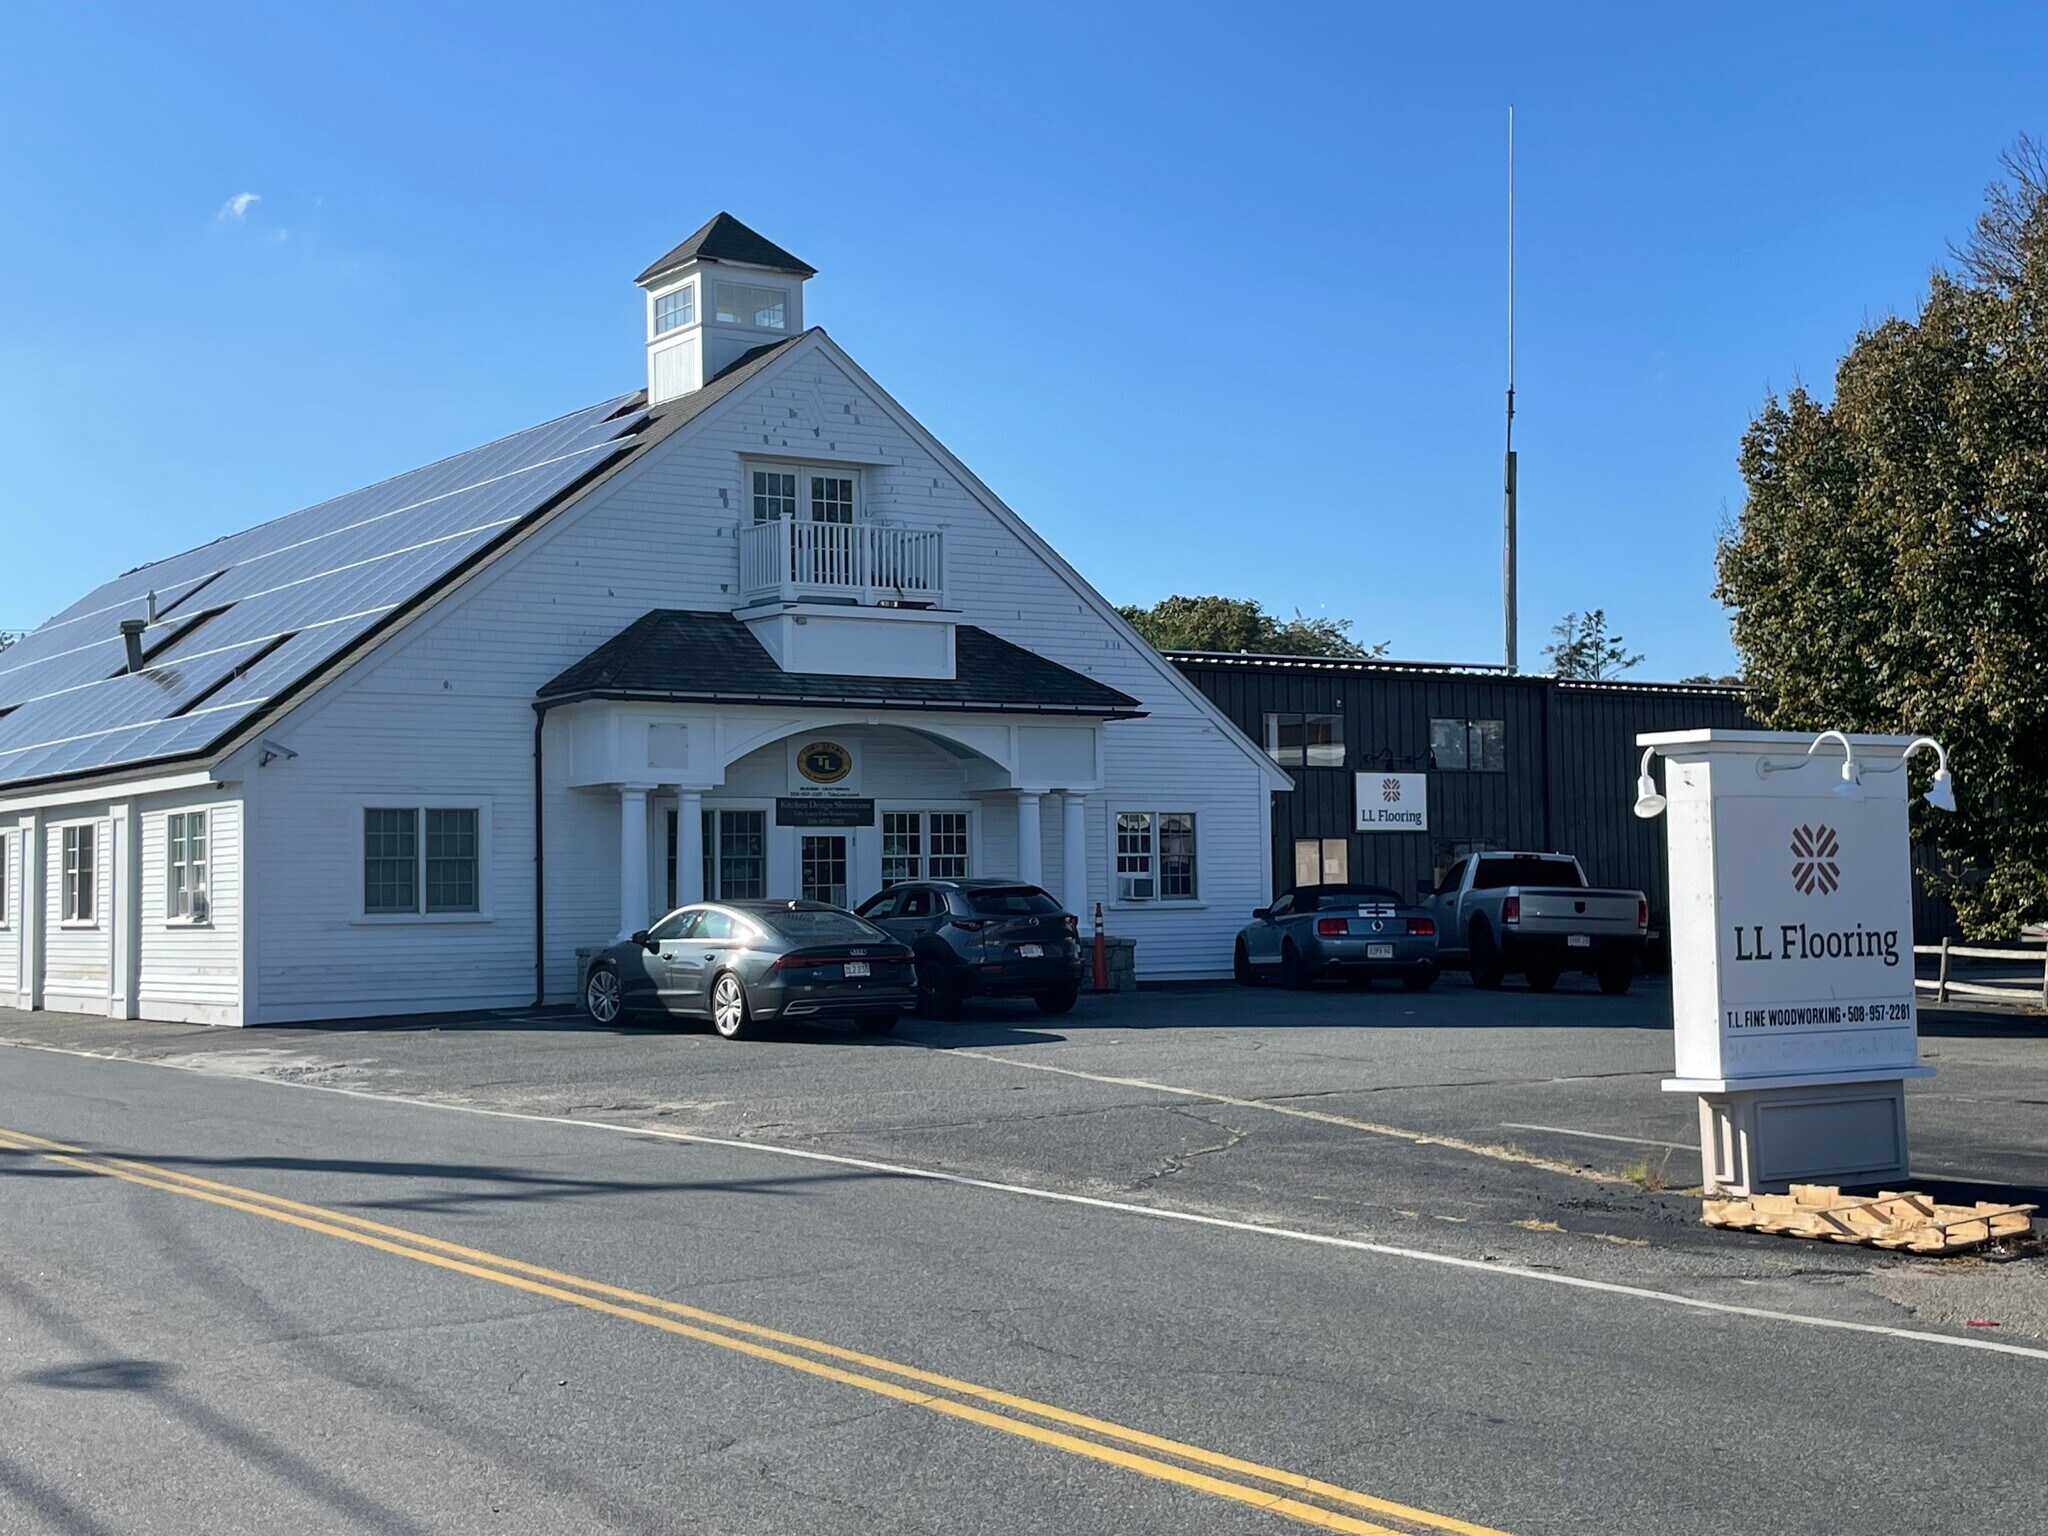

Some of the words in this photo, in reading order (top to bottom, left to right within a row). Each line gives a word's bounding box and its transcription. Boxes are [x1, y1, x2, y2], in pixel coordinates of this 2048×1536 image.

[812, 755, 837, 770] TL
[1362, 809, 1376, 822] LL
[1378, 809, 1422, 826] Flooring
[1735, 926, 1772, 961] LL
[1780, 923, 1899, 966] Flooring
[1745, 1010, 1766, 1028] FINE
